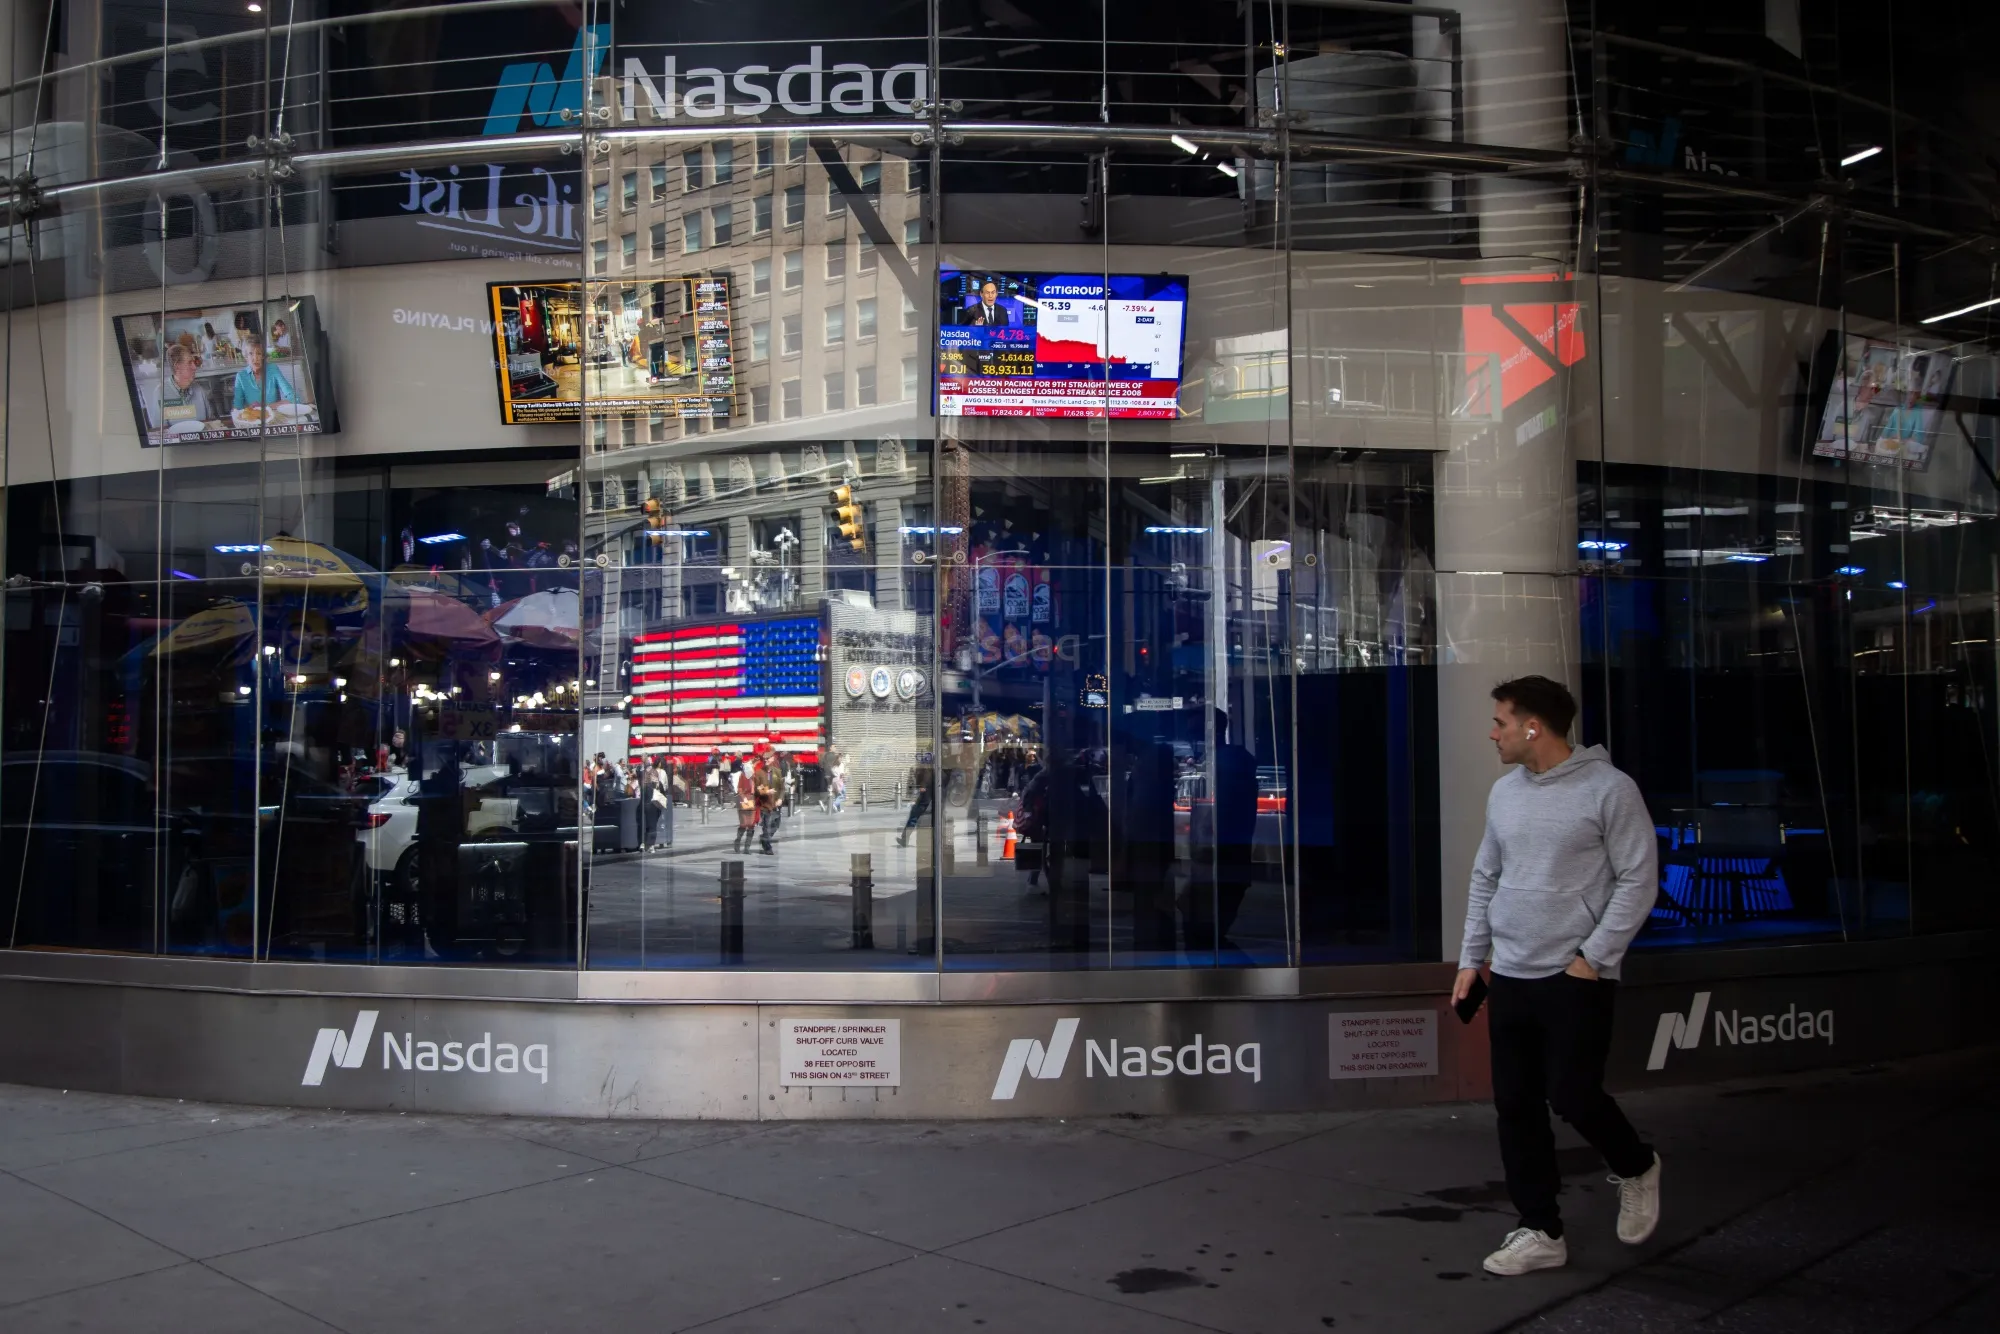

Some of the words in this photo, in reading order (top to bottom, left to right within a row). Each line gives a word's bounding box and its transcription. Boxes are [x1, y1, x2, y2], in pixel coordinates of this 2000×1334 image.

[622, 46, 927, 120] Nasdaq
[1043, 286, 1103, 295] CITIGROUP
[941, 330, 970, 338] Nasdaq
[997, 329, 1030, 340] 4.78%
[940, 339, 981, 347] Composite
[998, 354, 1034, 362] -1,614.82
[950, 365, 967, 374] DJI
[982, 365, 1034, 375] 38,931.11
[181, 432, 201, 441] NASDAQ
[1342, 1019, 1380, 1027] STANDPIPE
[1386, 1017, 1426, 1025] SPRINKLER
[1715, 1003, 1834, 1046] Nasdaq
[1344, 1030, 1379, 1038] SHUT-OFF
[1381, 1029, 1400, 1037] CURB
[796, 1037, 834, 1045] SHUT-OFF
[836, 1037, 858, 1045] CURB
[860, 1037, 884, 1045] VALVE
[383, 1031, 549, 1085] Nasdaq
[1085, 1033, 1261, 1084] Nasdaq
[1362, 1052, 1379, 1060] FEET
[1381, 1051, 1417, 1059] OPPOSITE
[1340, 1064, 1356, 1072] THIS
[1389, 1062, 1428, 1070] BROADWAY
